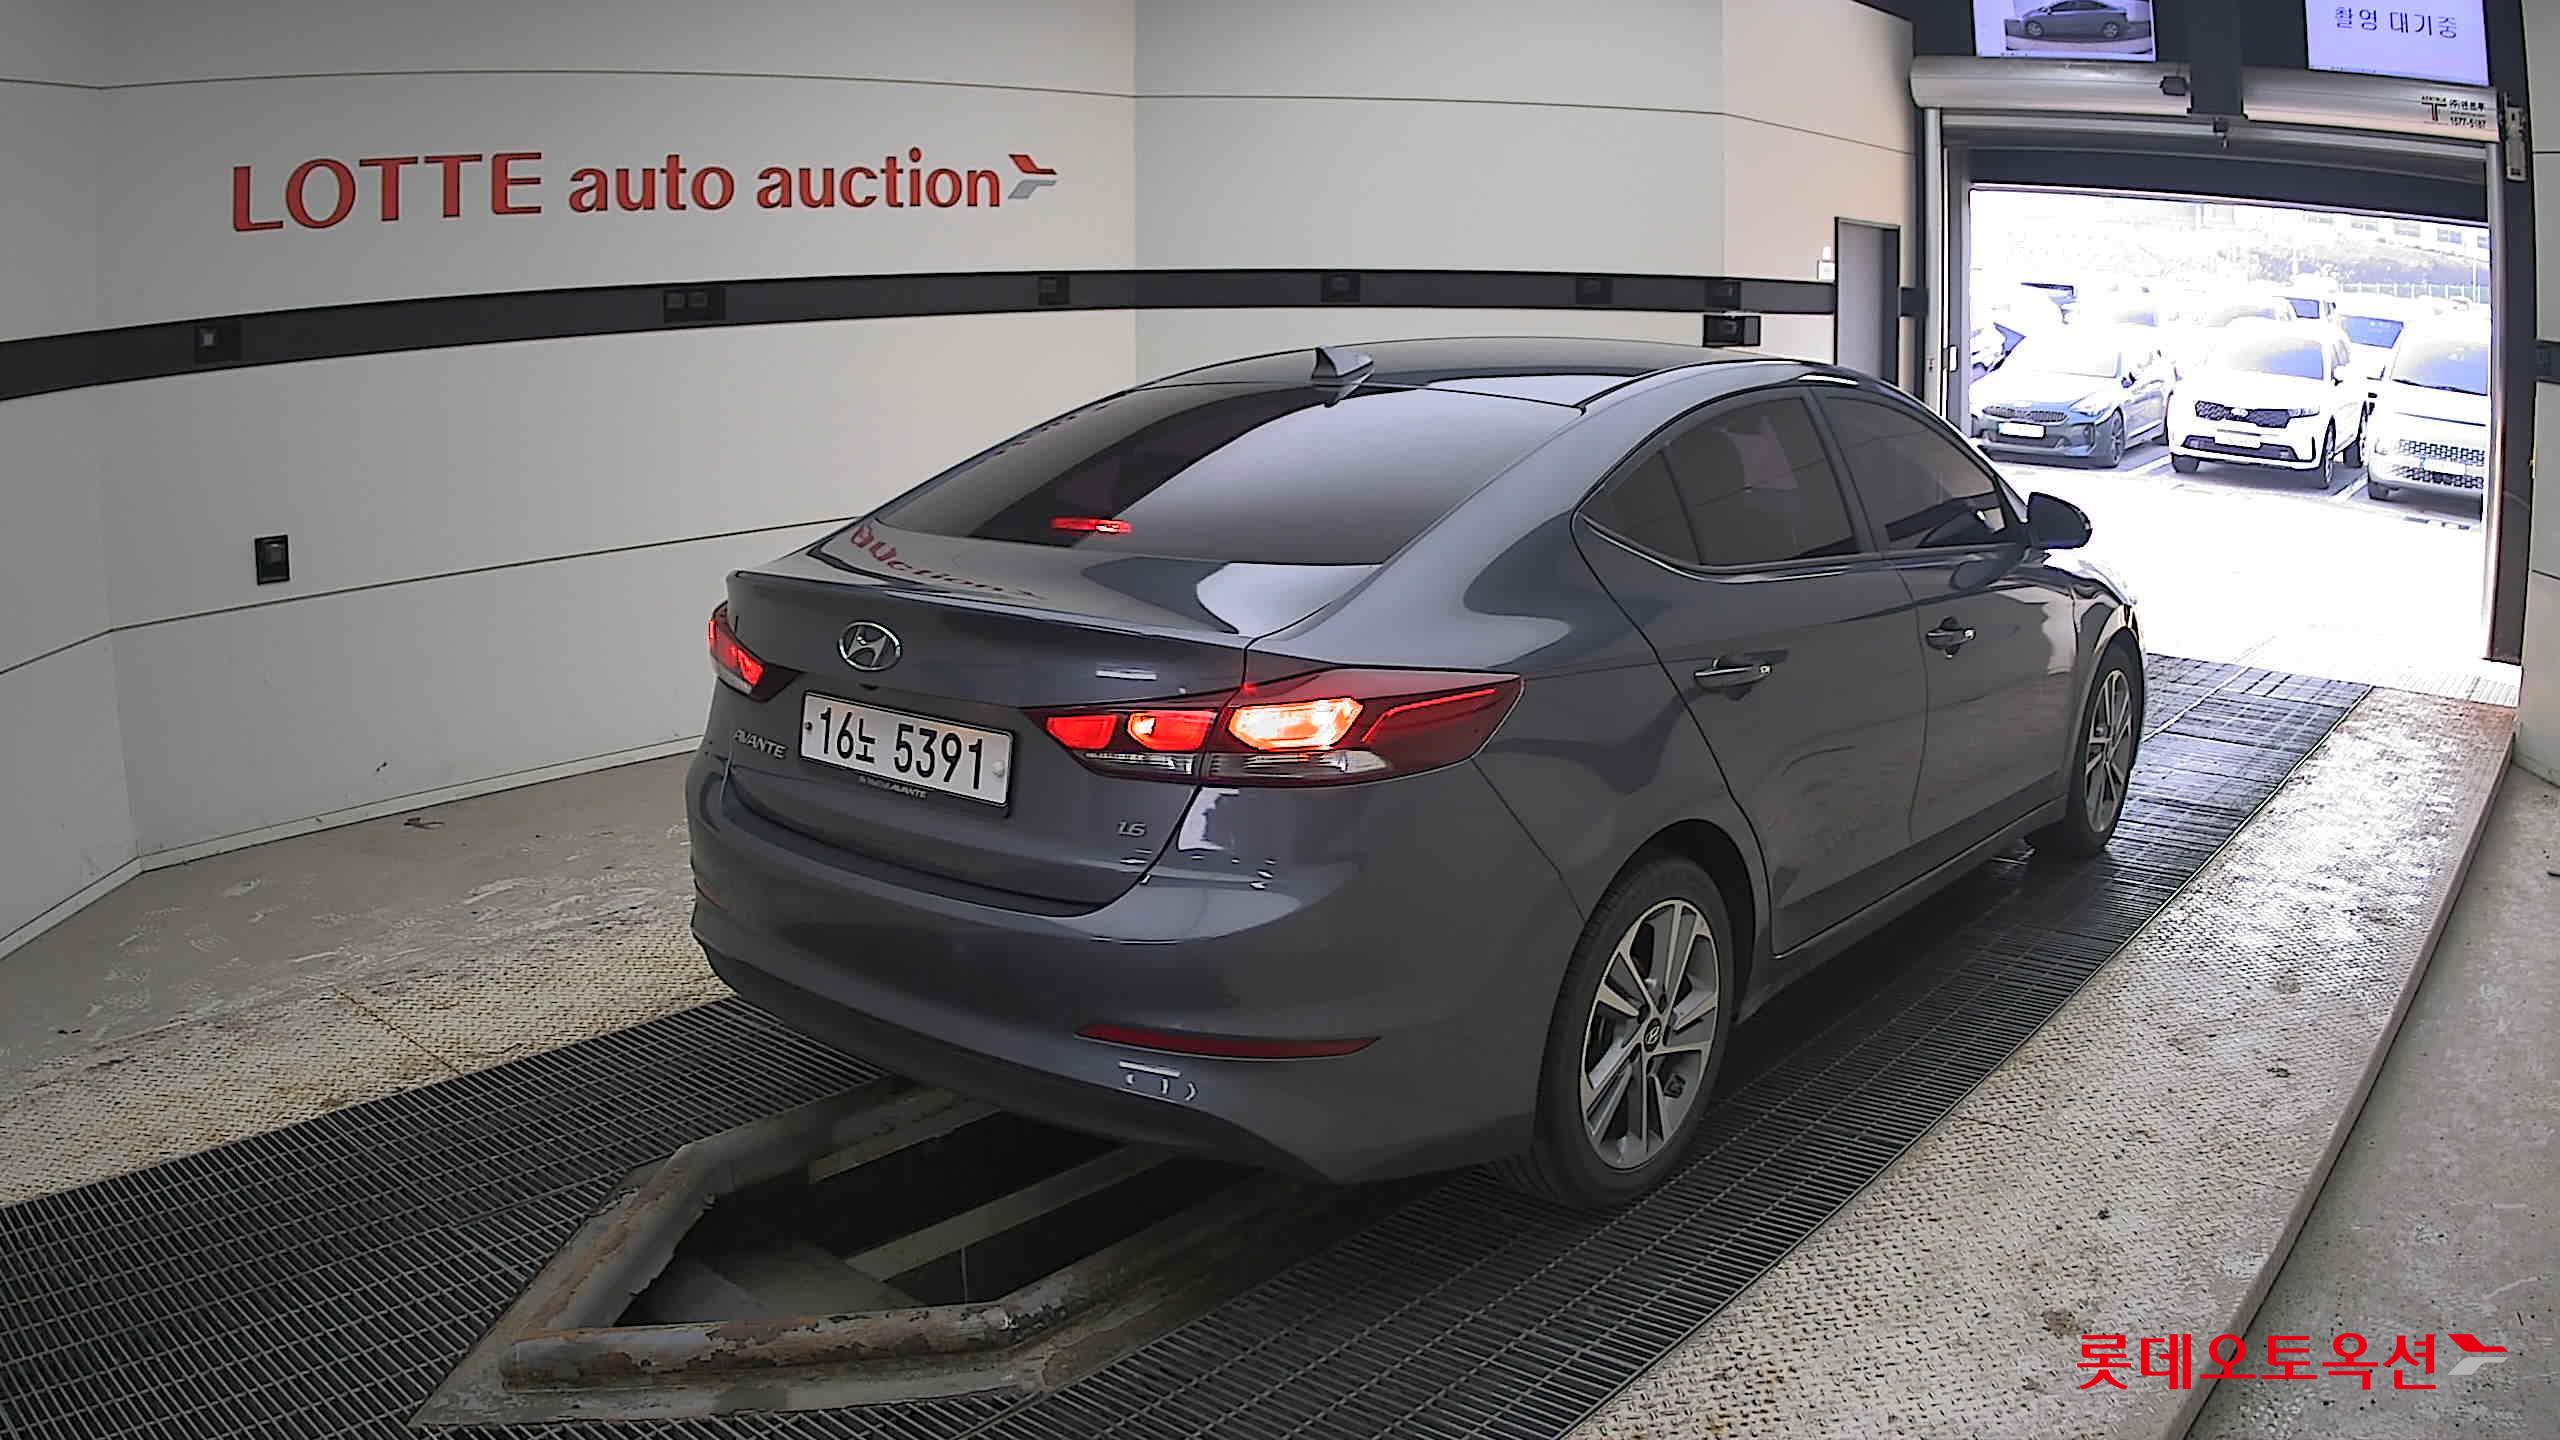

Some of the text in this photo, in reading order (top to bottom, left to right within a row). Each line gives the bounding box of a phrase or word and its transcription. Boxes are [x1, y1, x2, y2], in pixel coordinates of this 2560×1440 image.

[2335, 7, 2457, 39] 촬영 대기중
[233, 147, 1002, 232] LOTTE auto auction
[731, 728, 788, 760] AVANTE
[819, 706, 984, 790] 16노 5391
